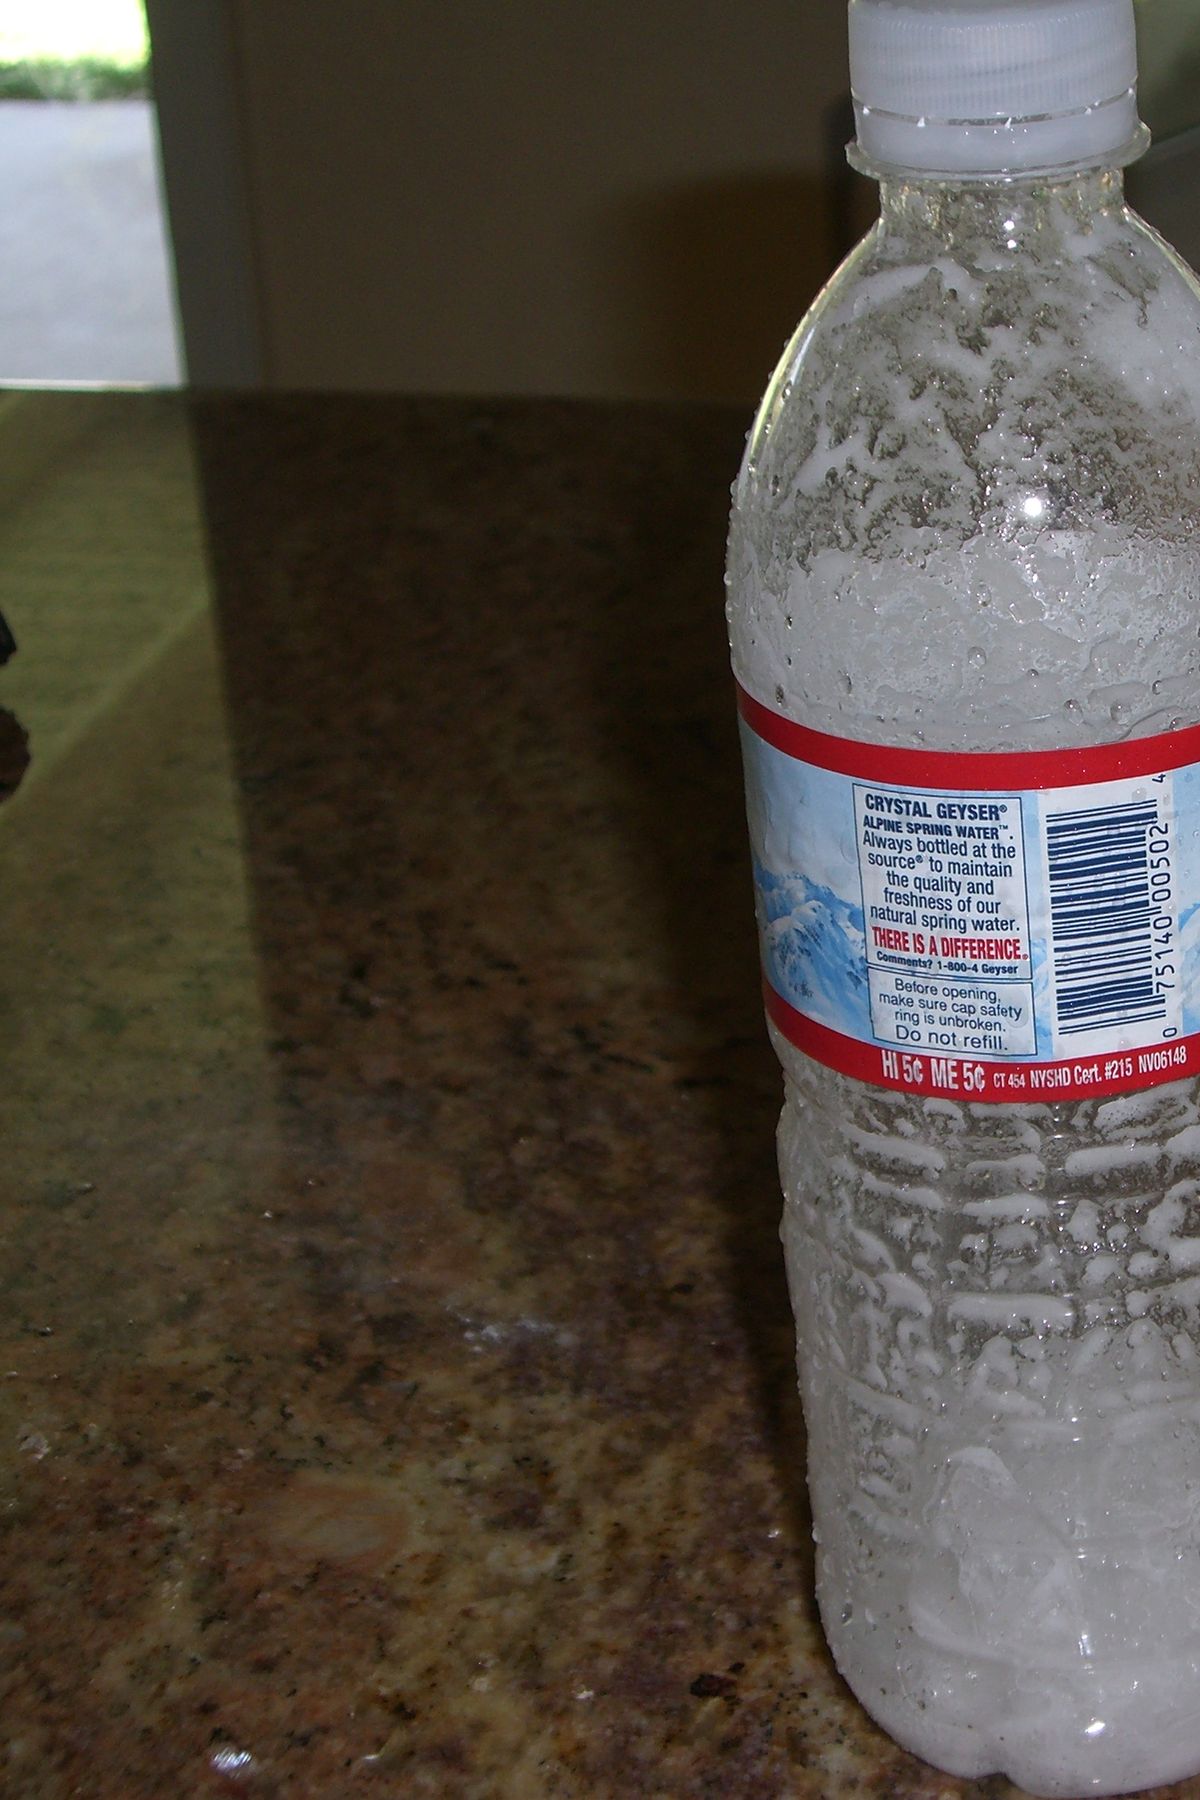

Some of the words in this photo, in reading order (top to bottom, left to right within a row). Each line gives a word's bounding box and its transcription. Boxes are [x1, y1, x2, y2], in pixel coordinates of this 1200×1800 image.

[865, 793, 932, 818] CRYSTAL
[863, 815, 903, 833] ALPINE
[906, 821, 952, 837] SPRING
[863, 830, 913, 854] Always
[917, 837, 968, 857] bottled
[972, 845, 988, 858] at
[991, 843, 1016, 859] the
[929, 857, 943, 873] to
[948, 860, 1013, 877] maintain
[1149, 822, 1172, 903] 00502
[886, 871, 909, 888] the
[914, 876, 962, 897] quality
[967, 880, 995, 896] and
[884, 888, 953, 912] freshness
[957, 897, 974, 913] of
[976, 901, 1001, 914] our
[870, 905, 917, 926] natural
[921, 914, 967, 934] spring
[971, 919, 1021, 932] water.
[872, 926, 910, 952] THERE
[912, 933, 925, 955] IS
[929, 935, 938, 957] A
[1152, 915, 1175, 994] 75140
[877, 950, 933, 969] Comments?
[937, 961, 979, 973] 1-800-4
[981, 963, 1019, 977] Geyser
[895, 978, 938, 996] Before
[879, 992, 914, 1008] make
[918, 998, 948, 1012] sure
[951, 1002, 976, 1016] cap
[980, 1004, 1023, 1022] safety
[895, 1008, 920, 1026] ring
[924, 1011, 935, 1024] is
[939, 1014, 1006, 1032] unbroken.
[896, 1024, 922, 1042] Do
[928, 1030, 957, 1047] not
[963, 1033, 1009, 1050] refill.
[1163, 1026, 1177, 1038] 0
[881, 1049, 899, 1080] HI
[903, 1052, 923, 1084] 5¢
[930, 1056, 959, 1090] ME
[963, 1061, 985, 1093] 5¢
[993, 1072, 1006, 1088] CT
[1008, 1073, 1026, 1089] 454
[1030, 1066, 1071, 1089] NYSHD
[1074, 1063, 1102, 1085] Cert.
[1105, 1056, 1133, 1080] #215
[1138, 1044, 1187, 1074] NV06148
